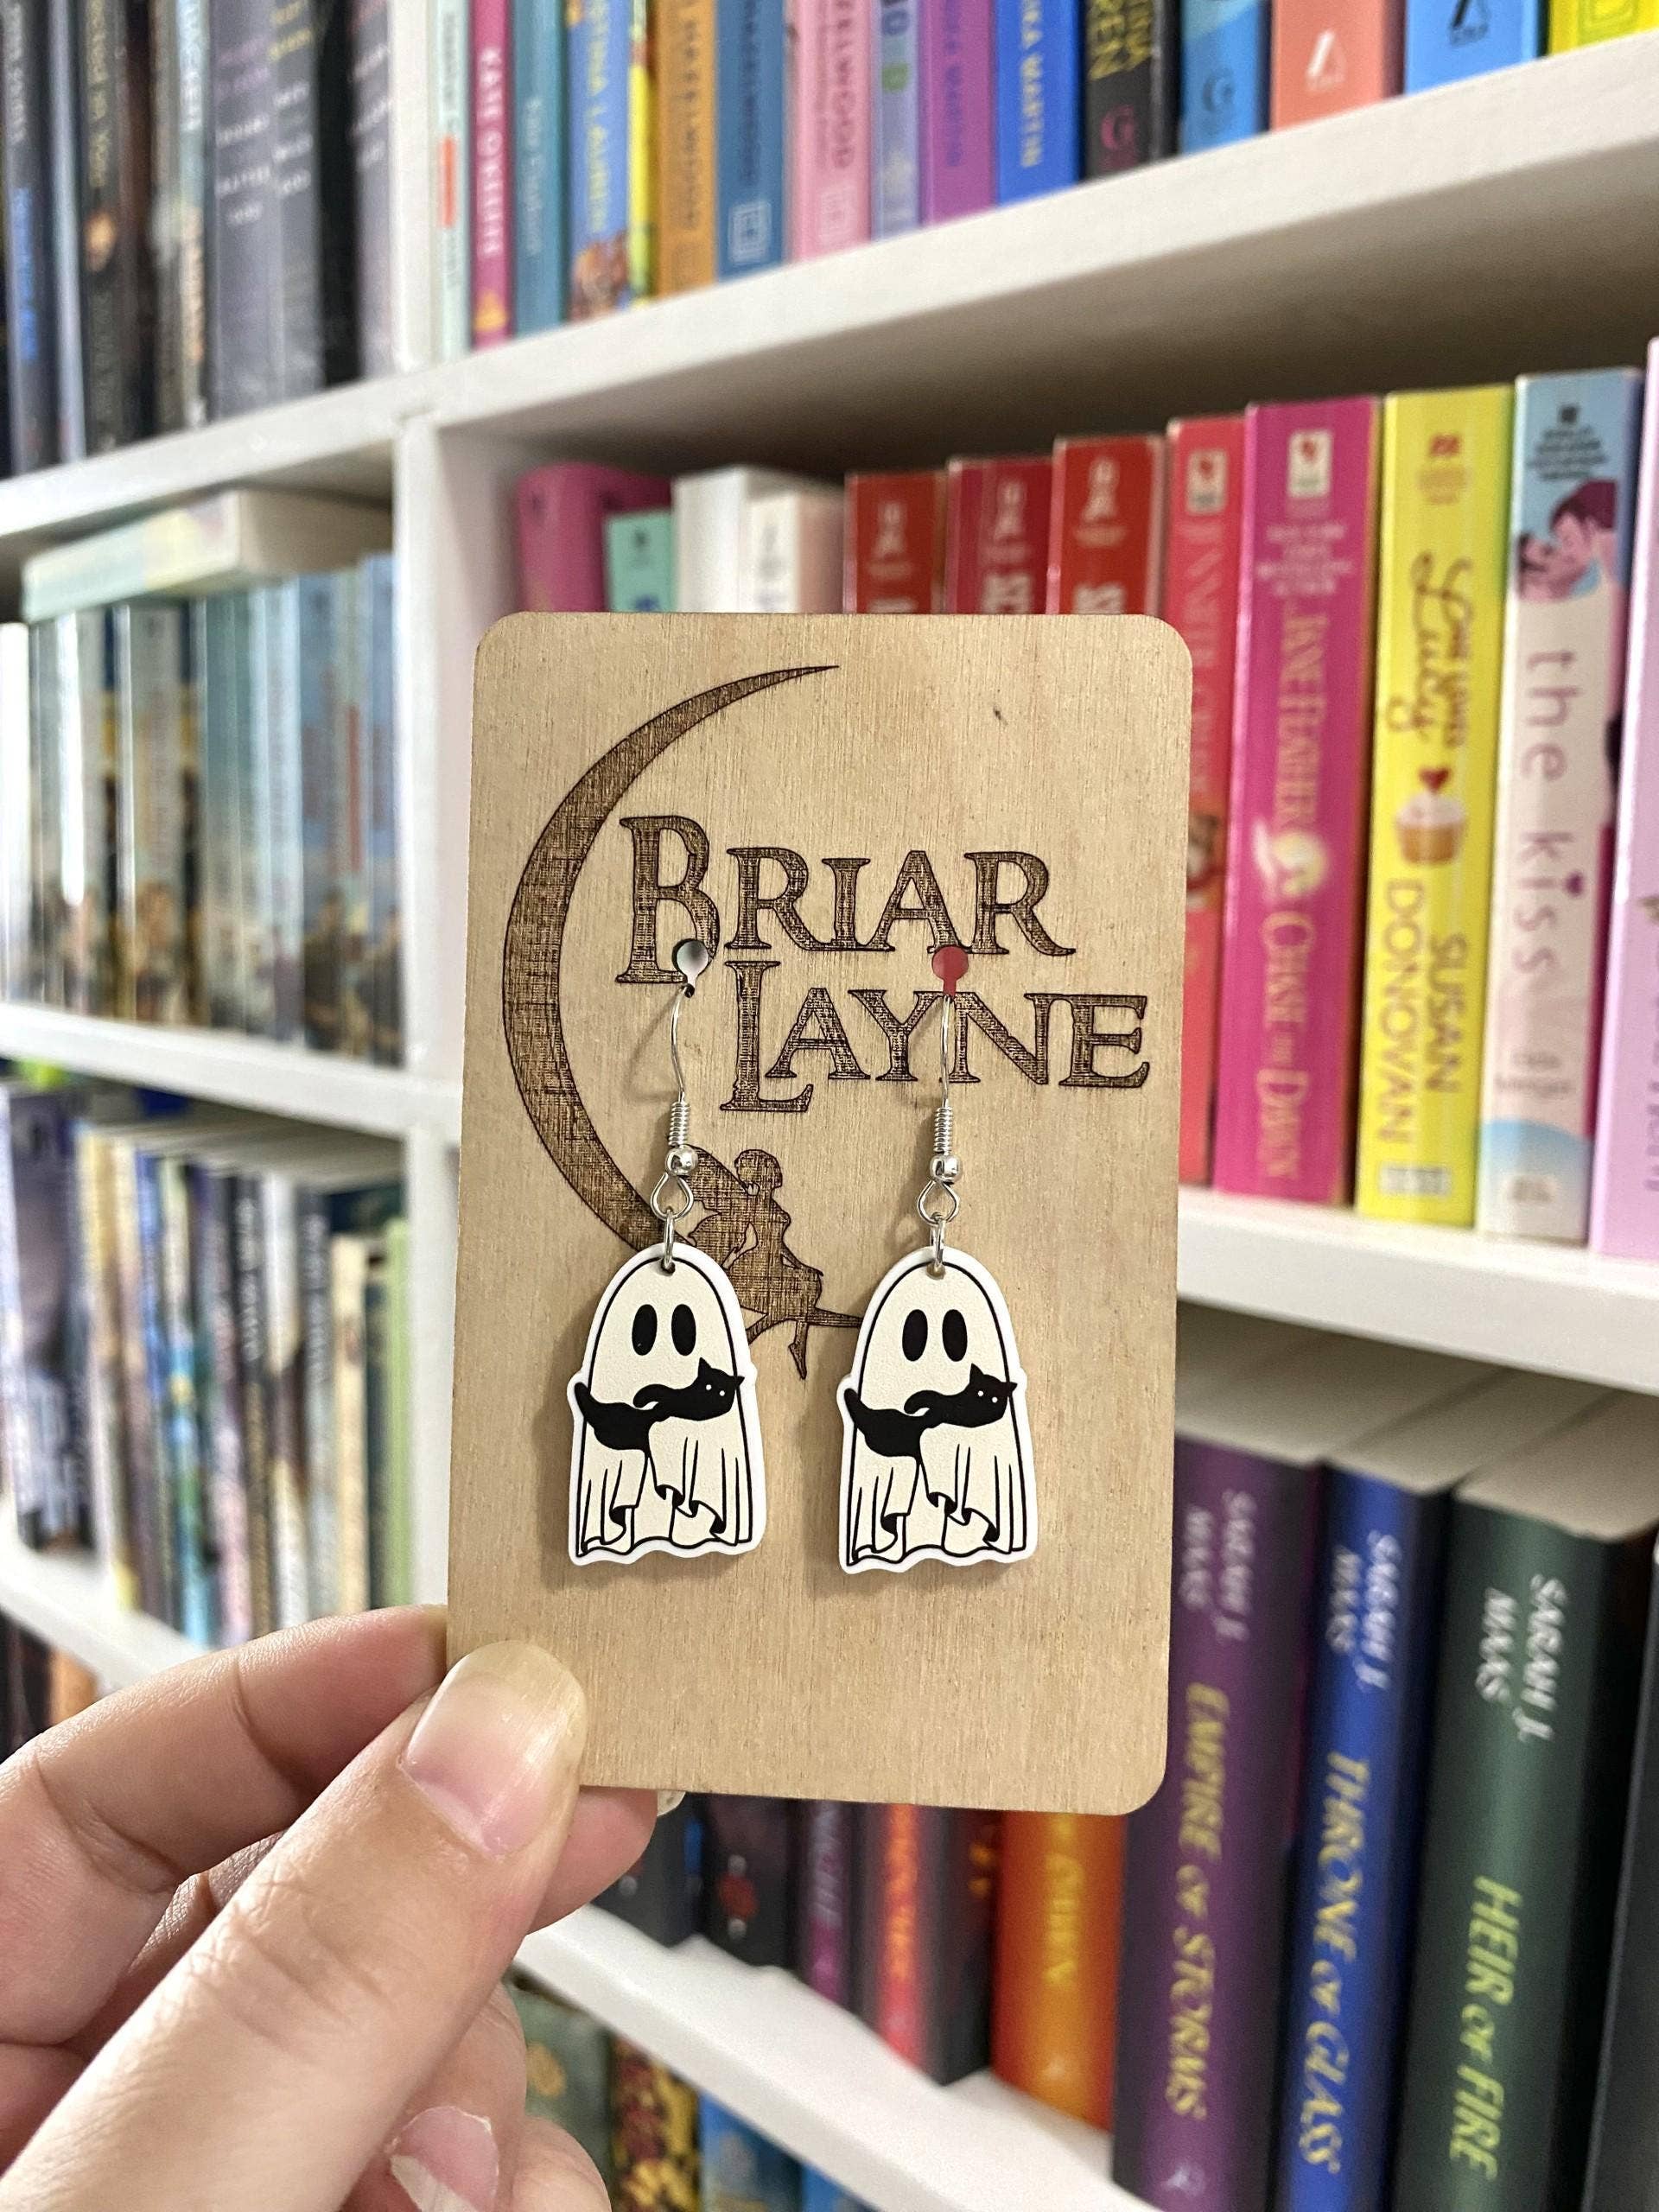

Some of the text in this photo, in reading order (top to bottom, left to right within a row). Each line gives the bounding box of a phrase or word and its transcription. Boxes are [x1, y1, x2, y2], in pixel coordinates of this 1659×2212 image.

[1520, 650, 1578, 782] the
[616, 815, 1077, 985] BRIAR
[1511, 830, 1585, 976] kiss
[720, 960, 1151, 1113] LAYNE
[1376, 879, 1425, 1145] DONOVAN
[1424, 932, 1467, 1094] SUSAN
[1362, 1529, 1400, 1659] SARAH
[1475, 1586, 1518, 1706] MAAS
[1522, 1573, 1566, 1709] SARAH
[1178, 1681, 1230, 1865] EMPIRE
[1313, 1750, 1372, 1963] THRONE
[1465, 1874, 1523, 2009] HEIR
[1165, 1924, 1215, 2121] STORMS
[1299, 2021, 1350, 2174] GLASS
[1448, 2063, 1505, 2182] FIRE
